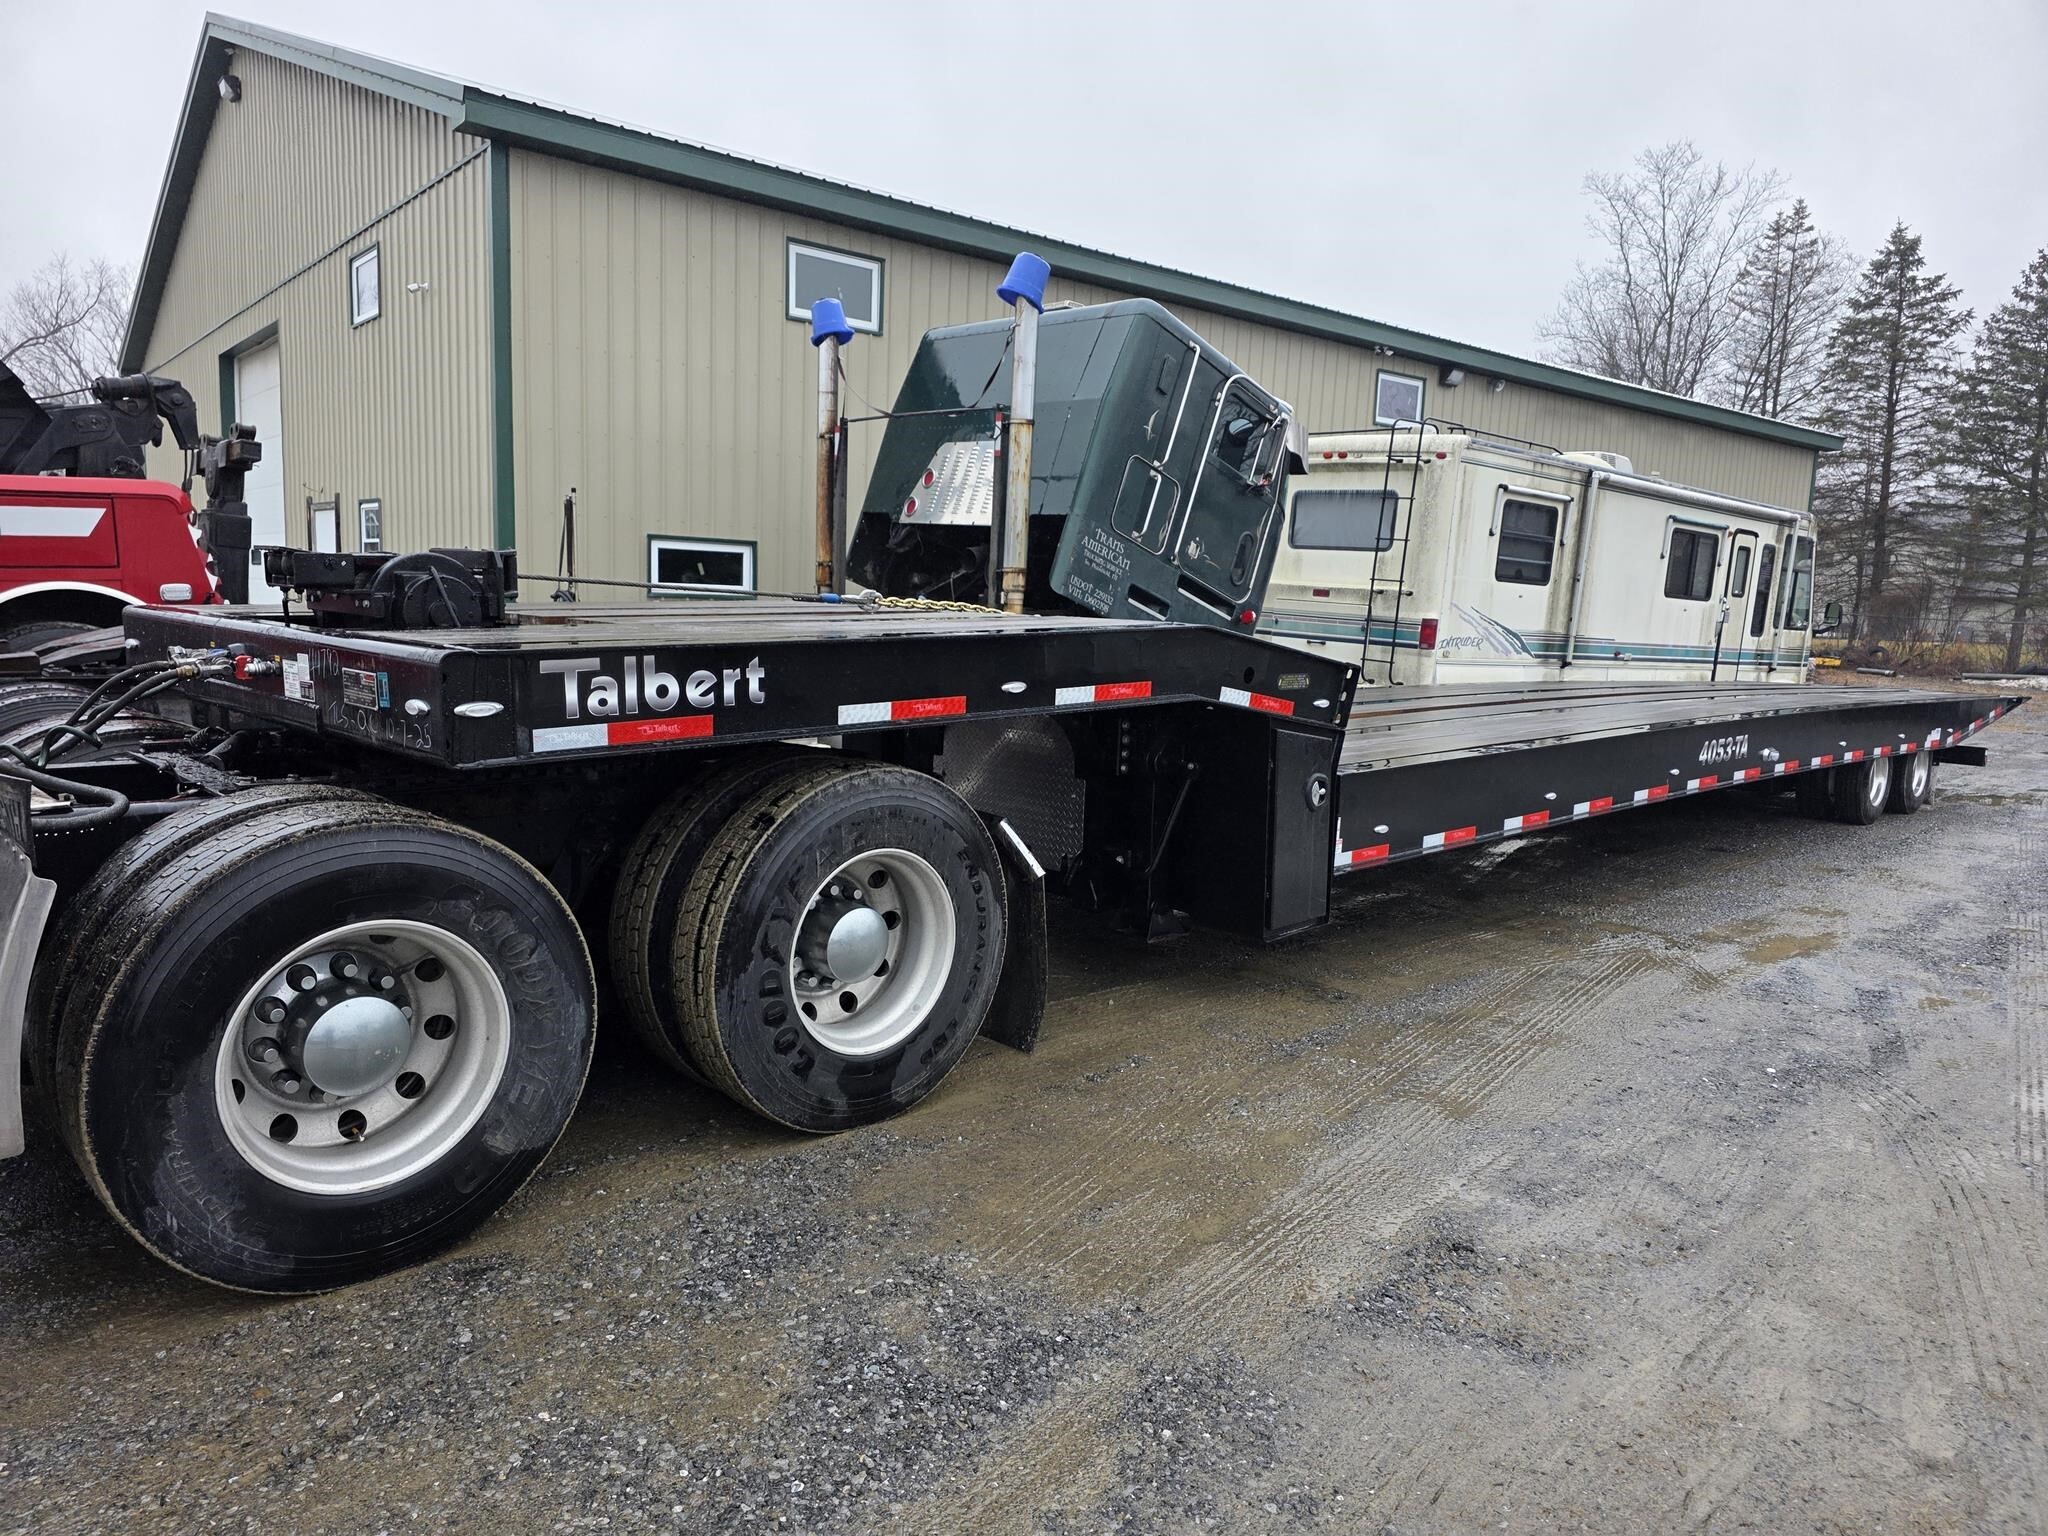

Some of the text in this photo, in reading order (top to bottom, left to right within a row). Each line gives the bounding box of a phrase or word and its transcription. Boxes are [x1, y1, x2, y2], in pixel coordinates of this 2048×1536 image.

[1081, 535, 1131, 570] AMERICAN
[1095, 527, 1125, 554] TRANS
[1070, 574, 1094, 594] USDOT
[1438, 636, 1484, 650] INTRUDER
[539, 654, 766, 719] Talbert
[655, 723, 680, 733] Talbert
[1698, 734, 1749, 766] 4053-TA
